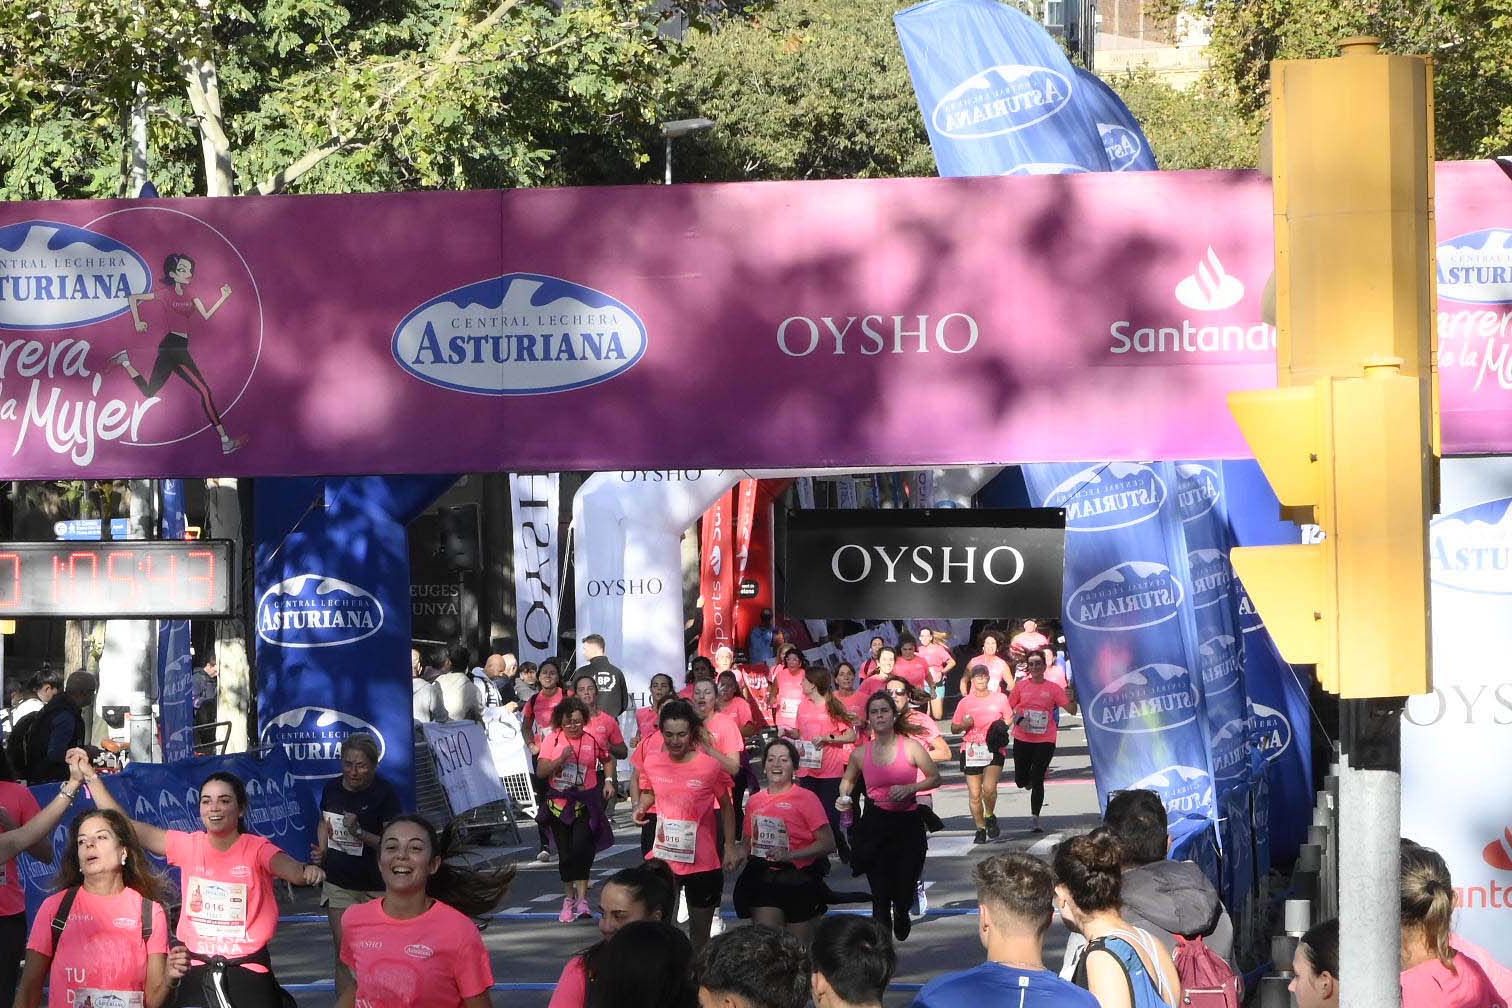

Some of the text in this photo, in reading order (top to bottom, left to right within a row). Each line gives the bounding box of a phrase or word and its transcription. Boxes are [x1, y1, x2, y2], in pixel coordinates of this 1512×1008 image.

[54, 257, 127, 270] LECHERA
[451, 313, 618, 330] CENTRAL LECHERA
[412, 320, 627, 365] ASTURIANA
[776, 312, 979, 358] OYSHO
[1109, 321, 1277, 353] Santand
[13, 374, 161, 467] Mujer
[831, 544, 1025, 585] OYSHO
[587, 577, 663, 597] OYSHO
[273, 599, 317, 608] CENTRAL
[261, 604, 375, 632] ASTURIANA
[666, 835, 680, 843] 016
[760, 832, 776, 840] 016
[204, 903, 224, 912] 016
[65, 968, 86, 984] TU
